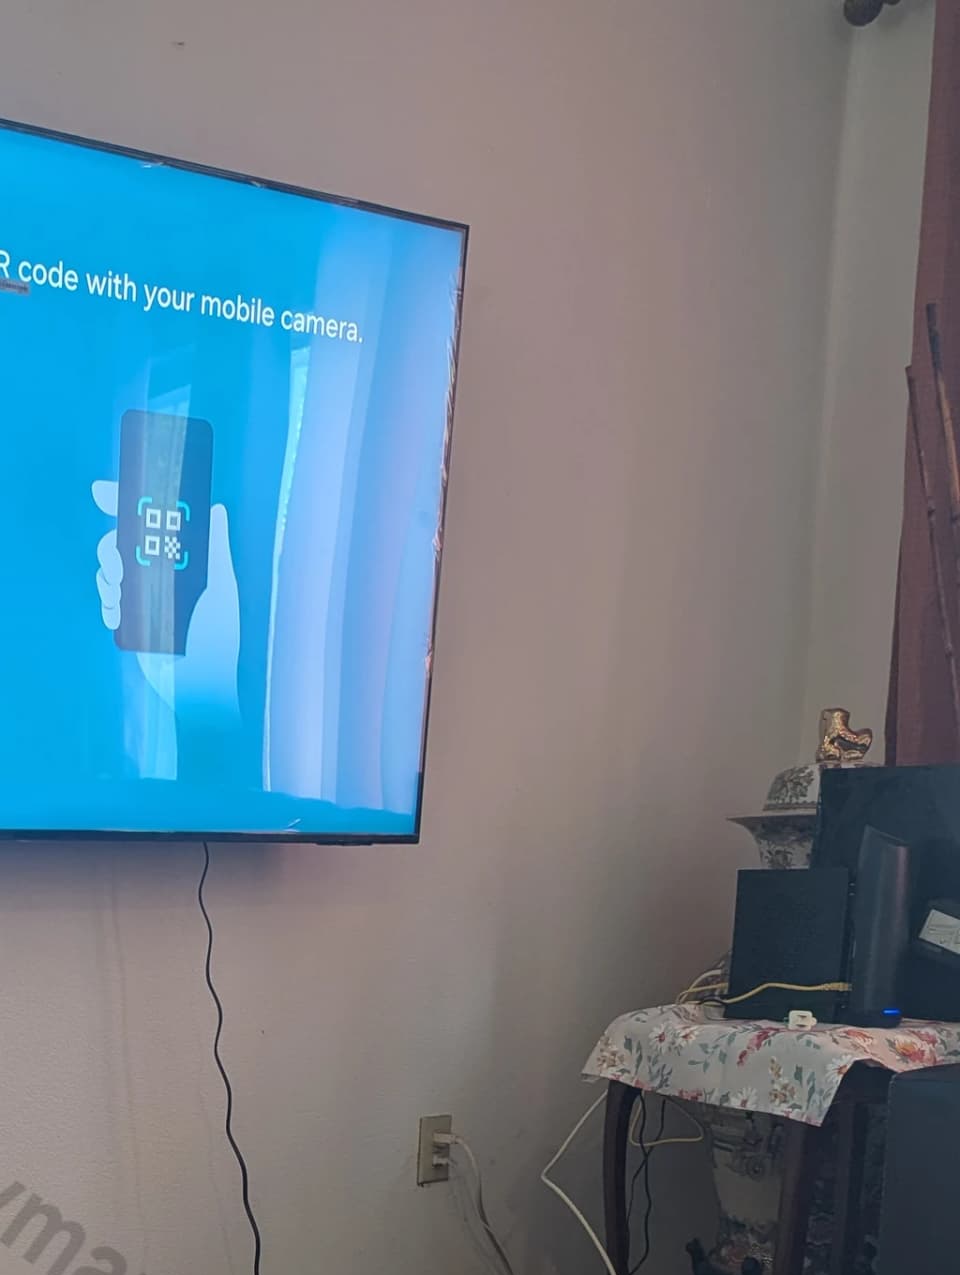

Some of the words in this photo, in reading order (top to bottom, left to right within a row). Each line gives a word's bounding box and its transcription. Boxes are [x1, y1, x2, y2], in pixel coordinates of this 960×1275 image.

[18, 260, 78, 291] code
[86, 271, 137, 301] with
[144, 283, 195, 311] your
[201, 294, 274, 326] mobile
[281, 309, 363, 343] camera.
